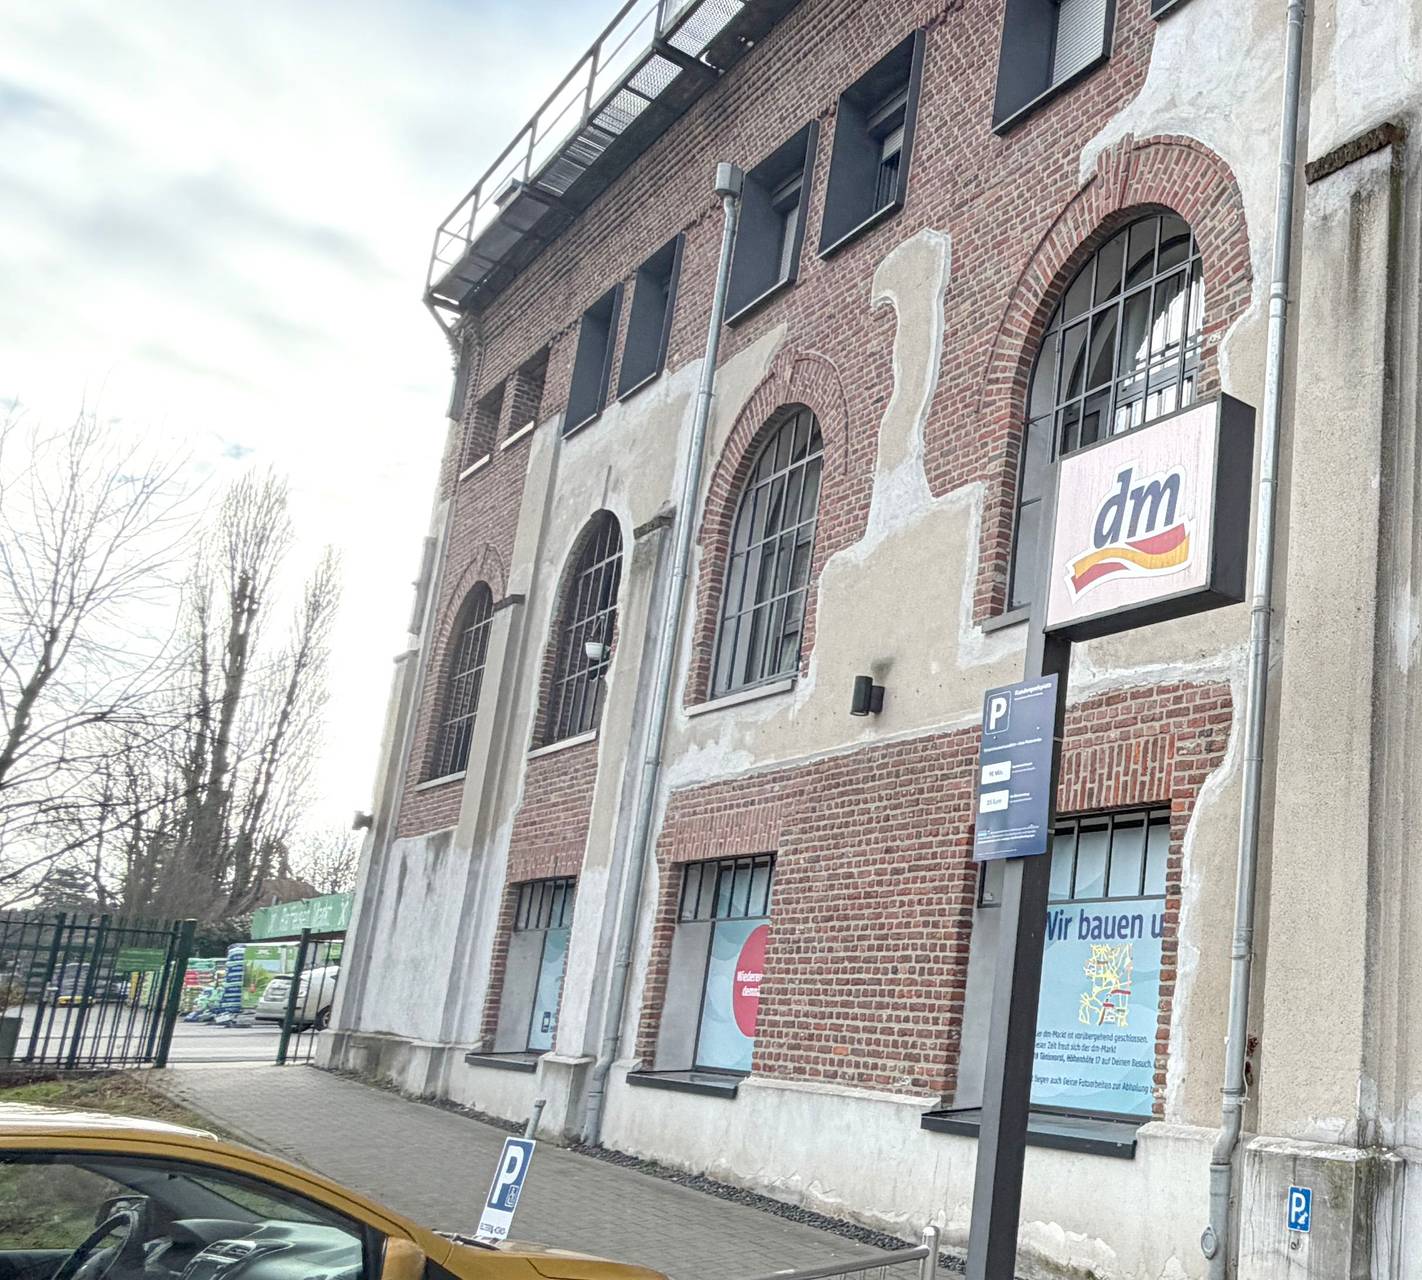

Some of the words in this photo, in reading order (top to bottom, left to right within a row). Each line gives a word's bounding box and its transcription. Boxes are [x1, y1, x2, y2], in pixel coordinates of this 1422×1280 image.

[1093, 467, 1181, 549] dm
[989, 697, 1007, 731] P
[1078, 908, 1143, 940] bauen
[1150, 913, 1165, 938] u
[491, 1145, 524, 1204] P
[1291, 1192, 1306, 1223] P
